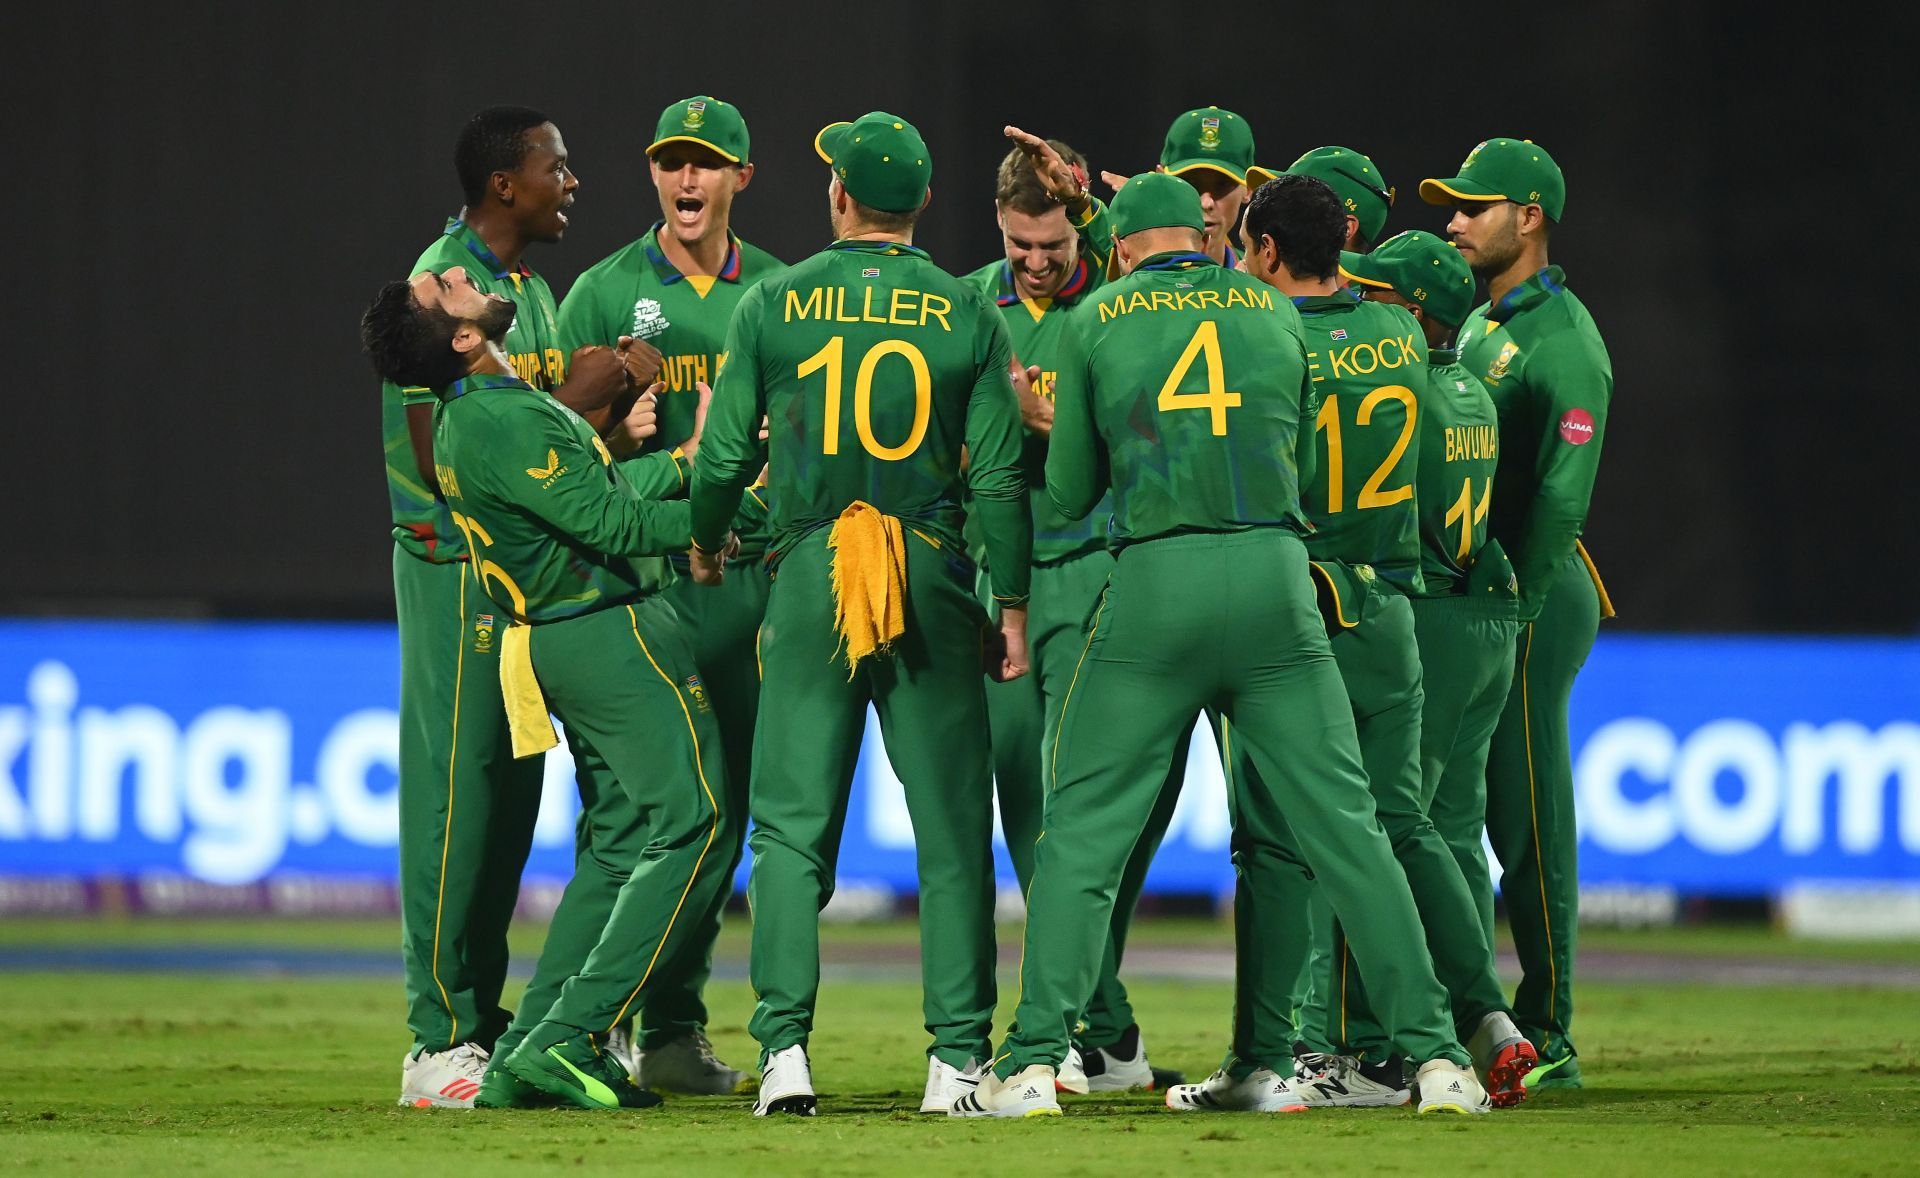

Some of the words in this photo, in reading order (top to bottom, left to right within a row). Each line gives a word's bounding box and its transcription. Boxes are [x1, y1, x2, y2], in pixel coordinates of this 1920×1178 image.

[1345, 198, 1357, 211] 94
[784, 285, 952, 332] MILLER
[1097, 286, 1275, 323] MARKRAM
[1413, 288, 1426, 300] 83
[632, 326, 655, 338] WORLD
[657, 322, 669, 330] CUP
[655, 354, 708, 393] OUTH
[1328, 333, 1421, 379] KOCK
[1157, 320, 1241, 437] 4
[796, 335, 932, 461] 10
[1444, 425, 1496, 463] BAVUMA
[1561, 421, 1593, 433] VUMA
[1317, 384, 1419, 514] 12
[542, 465, 569, 490] CASTORE
[1445, 476, 1490, 567] 11
